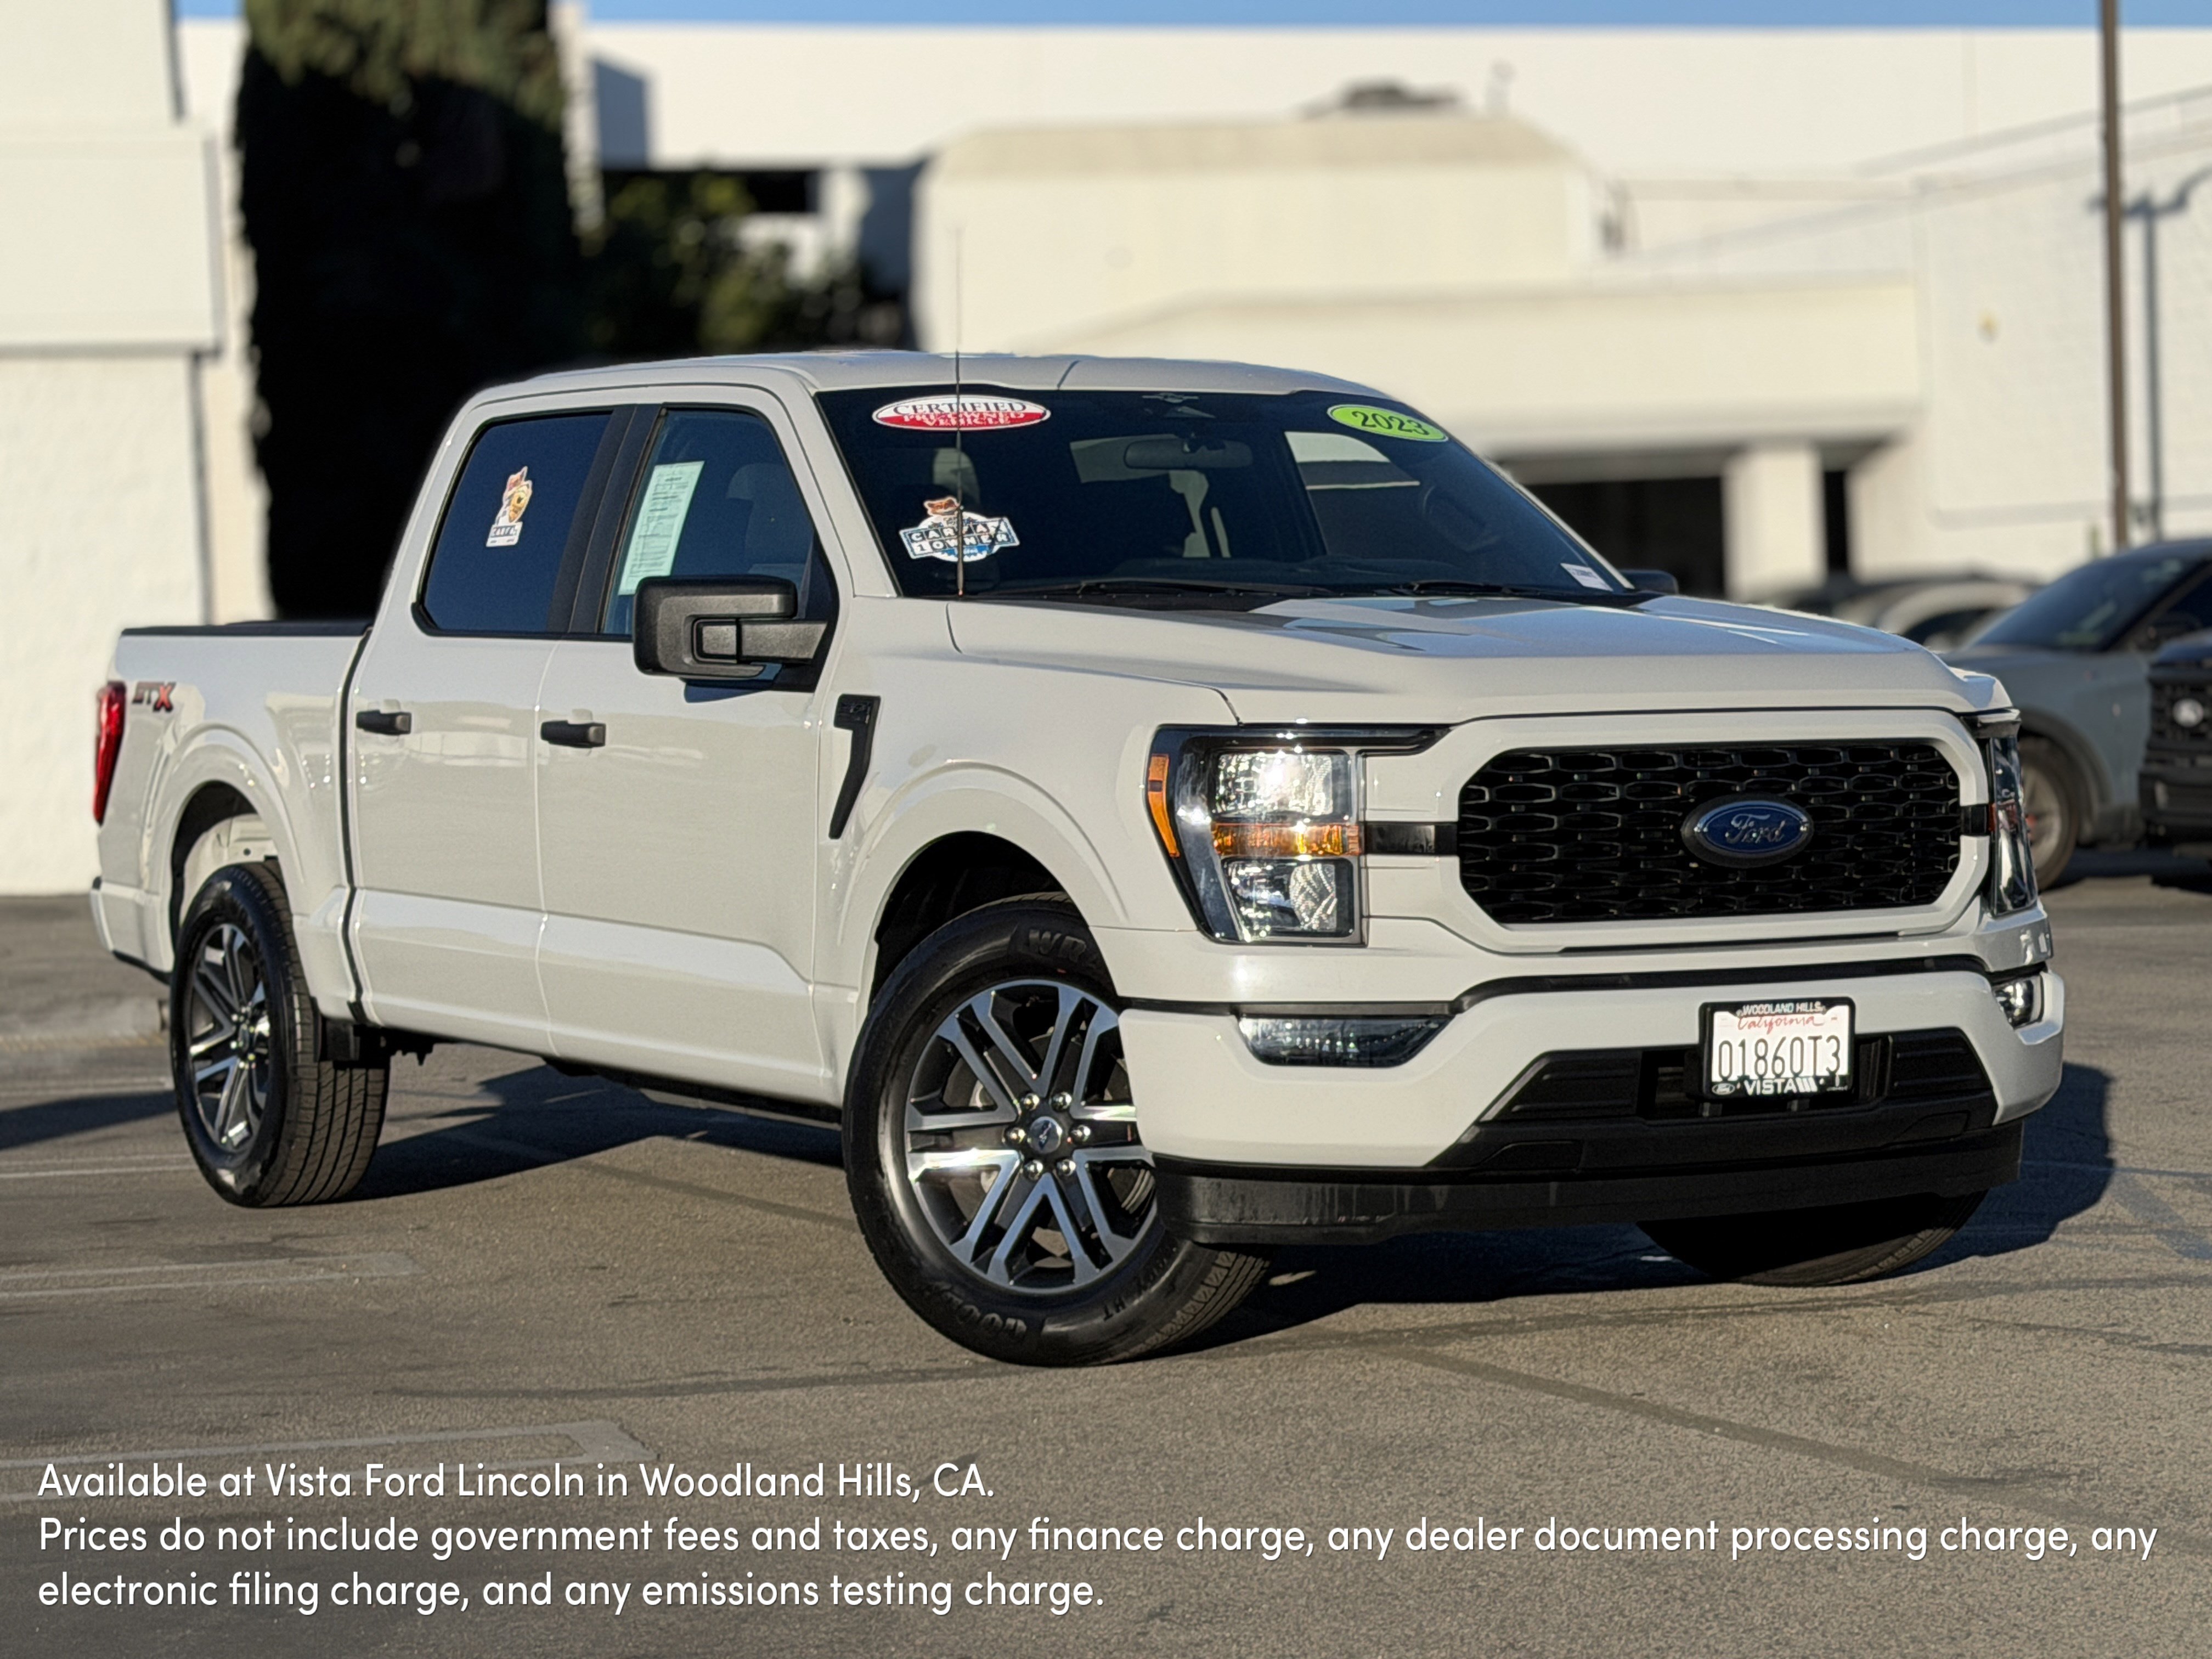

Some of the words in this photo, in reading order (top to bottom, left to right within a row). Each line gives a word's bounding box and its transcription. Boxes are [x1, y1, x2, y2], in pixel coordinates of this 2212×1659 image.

[893, 402, 1027, 415] CERTIFIED
[1352, 410, 1430, 436] 2023
[1726, 813, 1786, 844] Ford
[1742, 1002, 1793, 1015] WOODLAND
[1796, 1001, 1821, 1012] HILLS
[1737, 1015, 1824, 1035] California
[1718, 1035, 1841, 1080] 01860T3
[1744, 1077, 1797, 1095] VISTA
